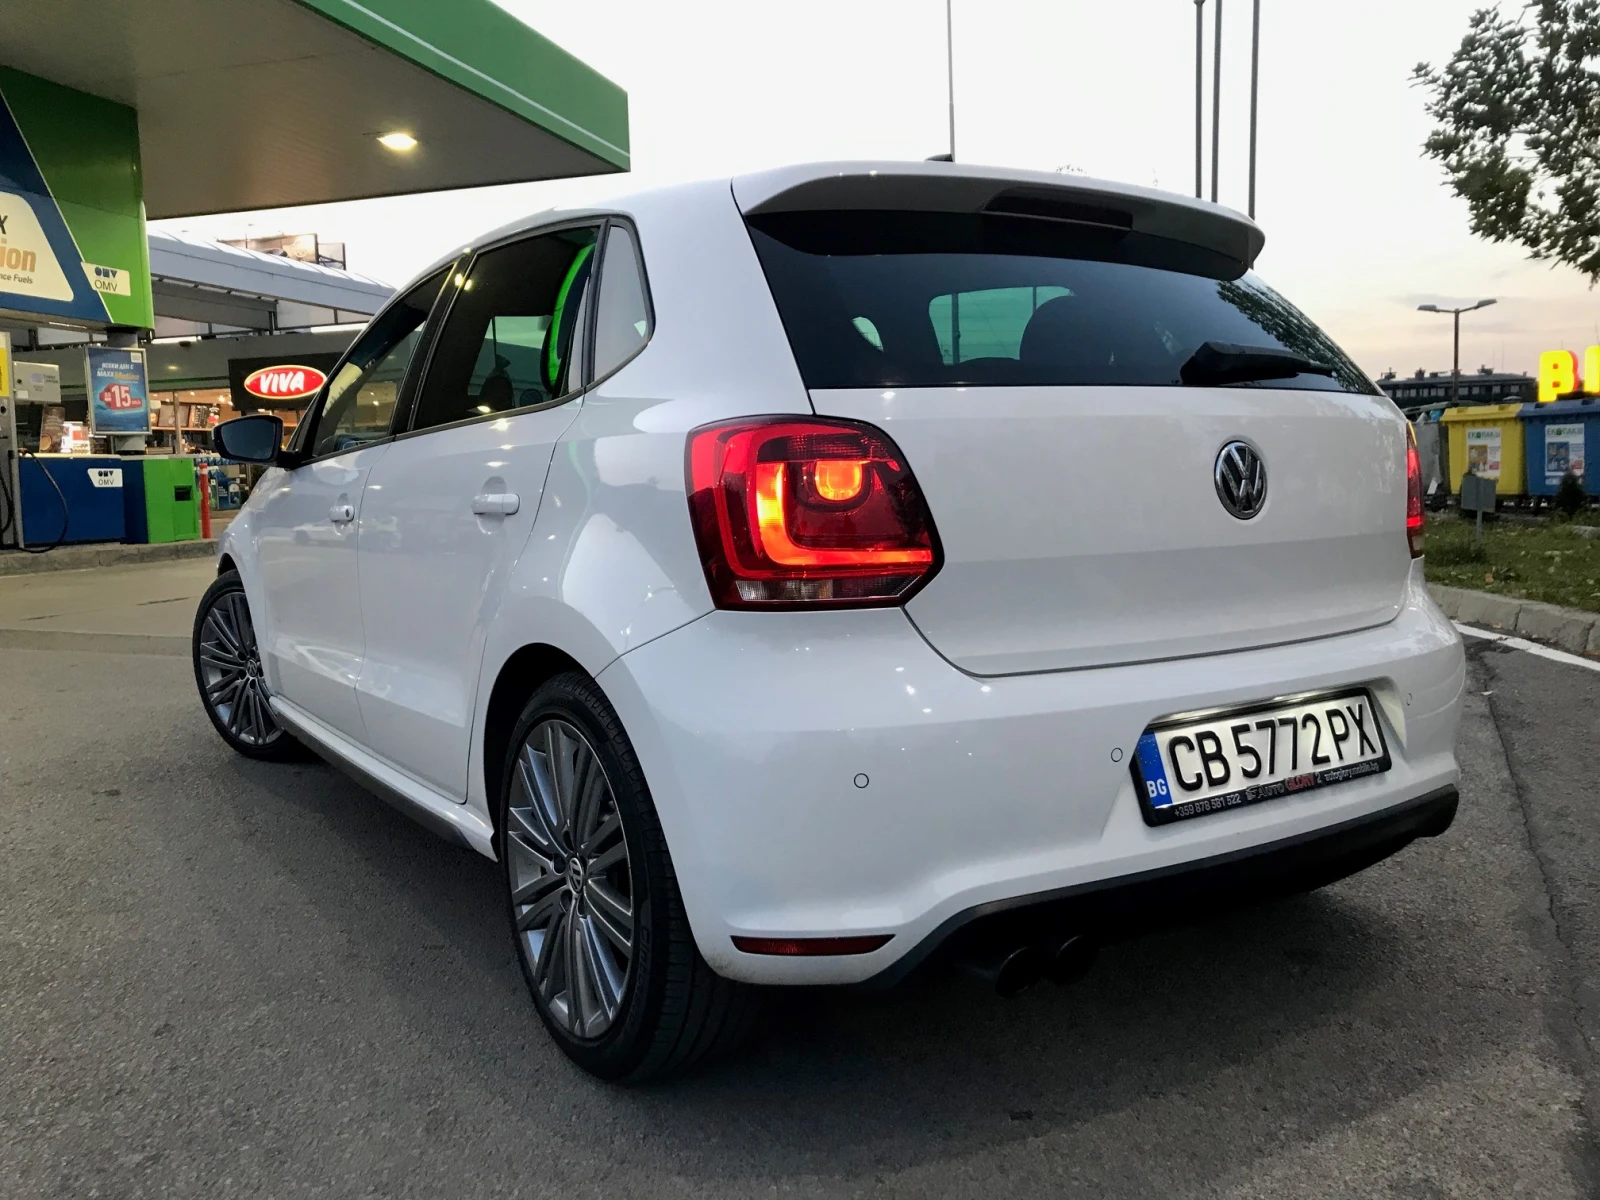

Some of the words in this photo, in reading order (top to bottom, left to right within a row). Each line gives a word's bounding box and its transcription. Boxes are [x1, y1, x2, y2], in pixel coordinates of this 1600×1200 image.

[14, 274, 33, 284] Fuels
[94, 280, 118, 292] OMV
[259, 371, 305, 393] VIVA
[111, 385, 131, 407] 15
[1146, 778, 1167, 798] BG
[1174, 804, 1194, 817] +359
[1195, 800, 1211, 813] 878
[1226, 793, 1242, 806] 522
[1285, 773, 1315, 791] GLORY
